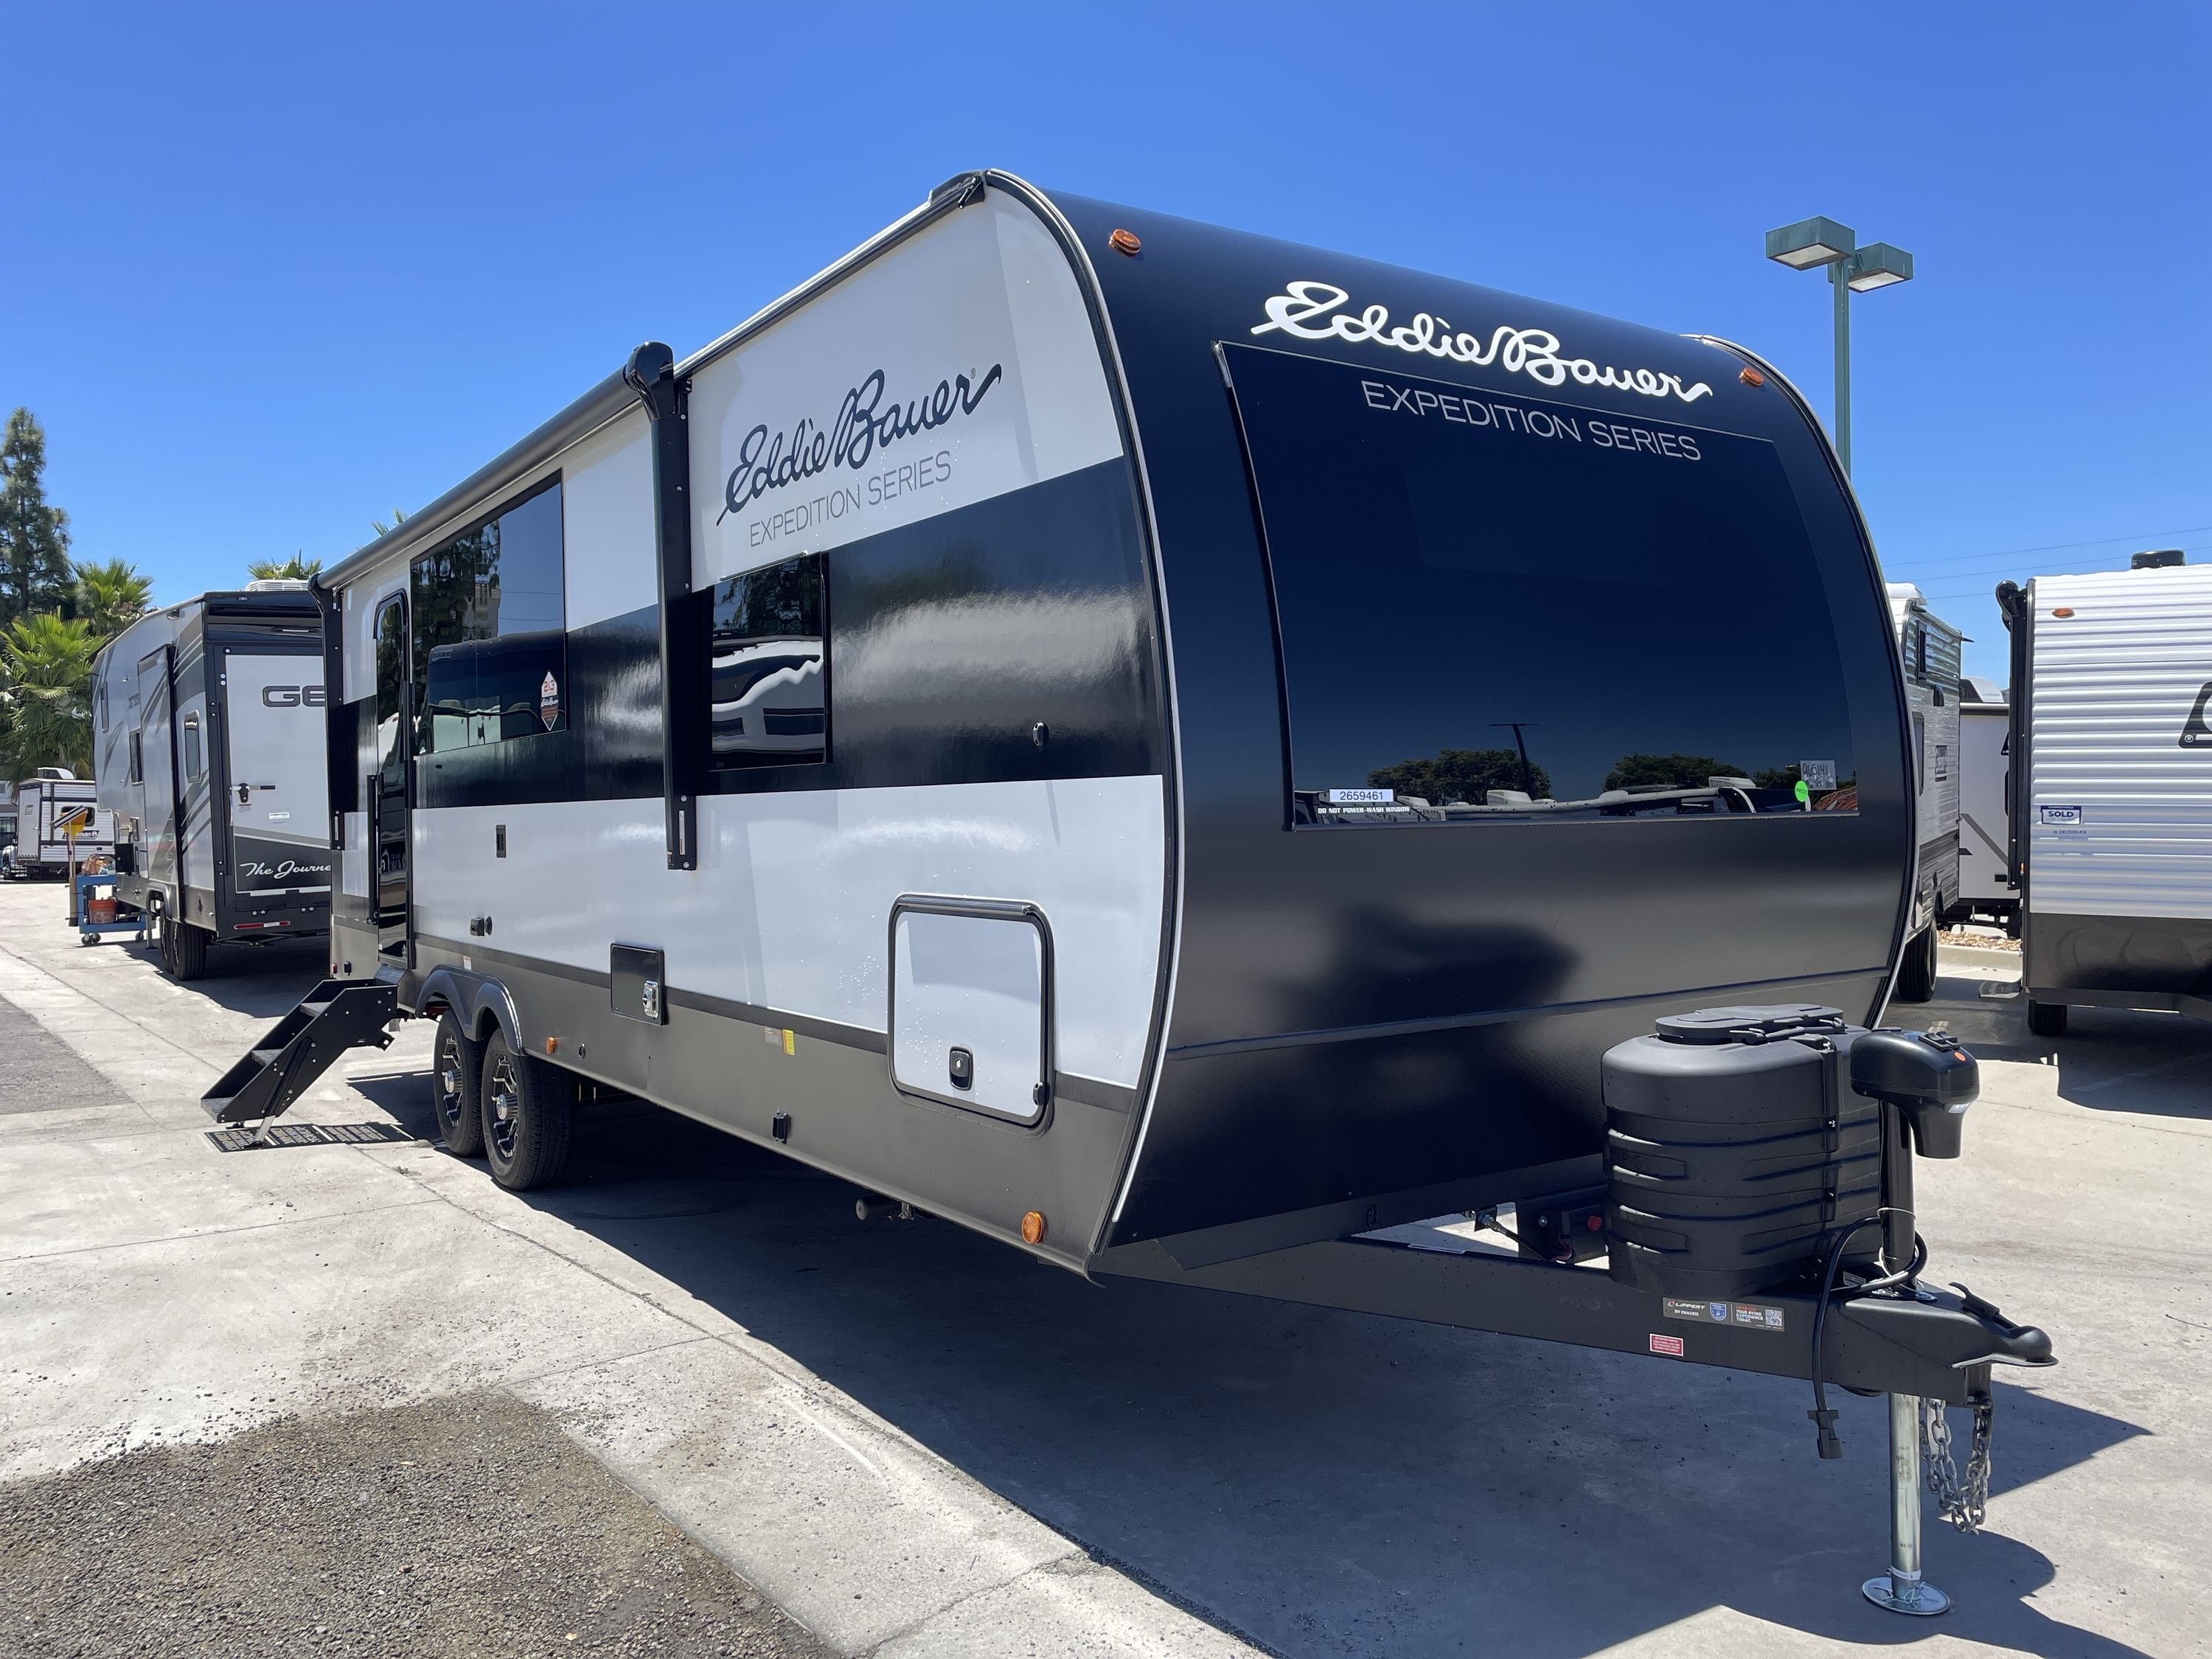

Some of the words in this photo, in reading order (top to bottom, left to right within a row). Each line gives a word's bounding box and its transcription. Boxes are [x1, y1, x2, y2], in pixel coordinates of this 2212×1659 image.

[1251, 281, 1480, 364] Eddie
[1361, 380, 1582, 442] EXPEDITION
[1587, 420, 1701, 461] SERIES
[717, 417, 827, 526] Eddie
[750, 483, 861, 548] EXPEDITION
[868, 450, 952, 507] SERIES
[1339, 790, 1383, 801] 2659461
[240, 862, 274, 877] The
